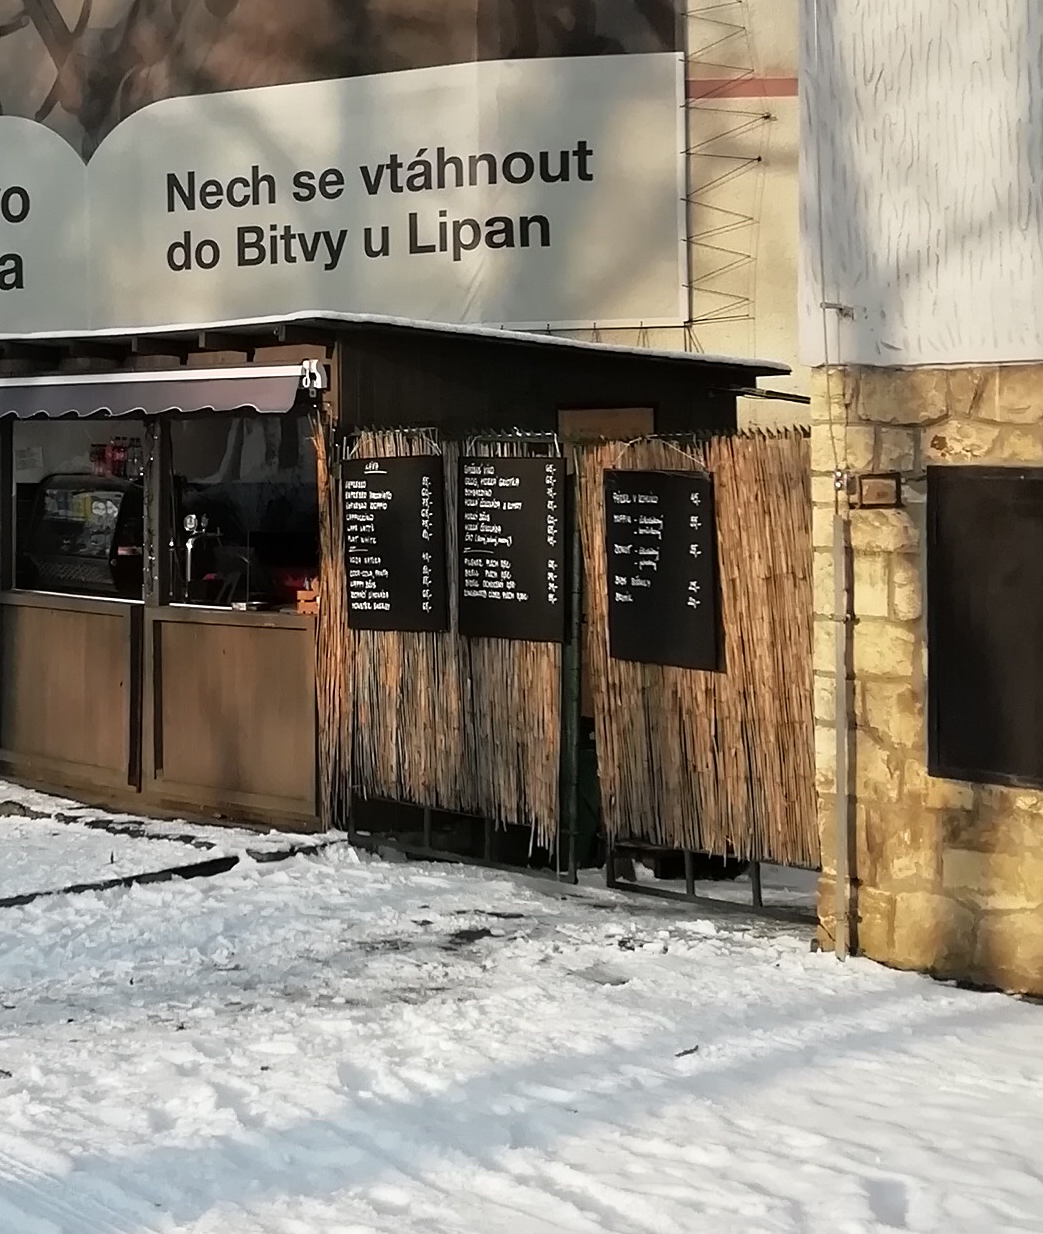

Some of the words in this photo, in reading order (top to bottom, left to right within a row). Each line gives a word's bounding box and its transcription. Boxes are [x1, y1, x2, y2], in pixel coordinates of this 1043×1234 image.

[167, 166, 275, 212] Nech
[293, 169, 344, 201] se
[360, 141, 593, 195] vtáhnout
[167, 231, 219, 271] do
[238, 224, 348, 270] Bitvy
[364, 227, 389, 257] u
[409, 211, 550, 261] Lipan
